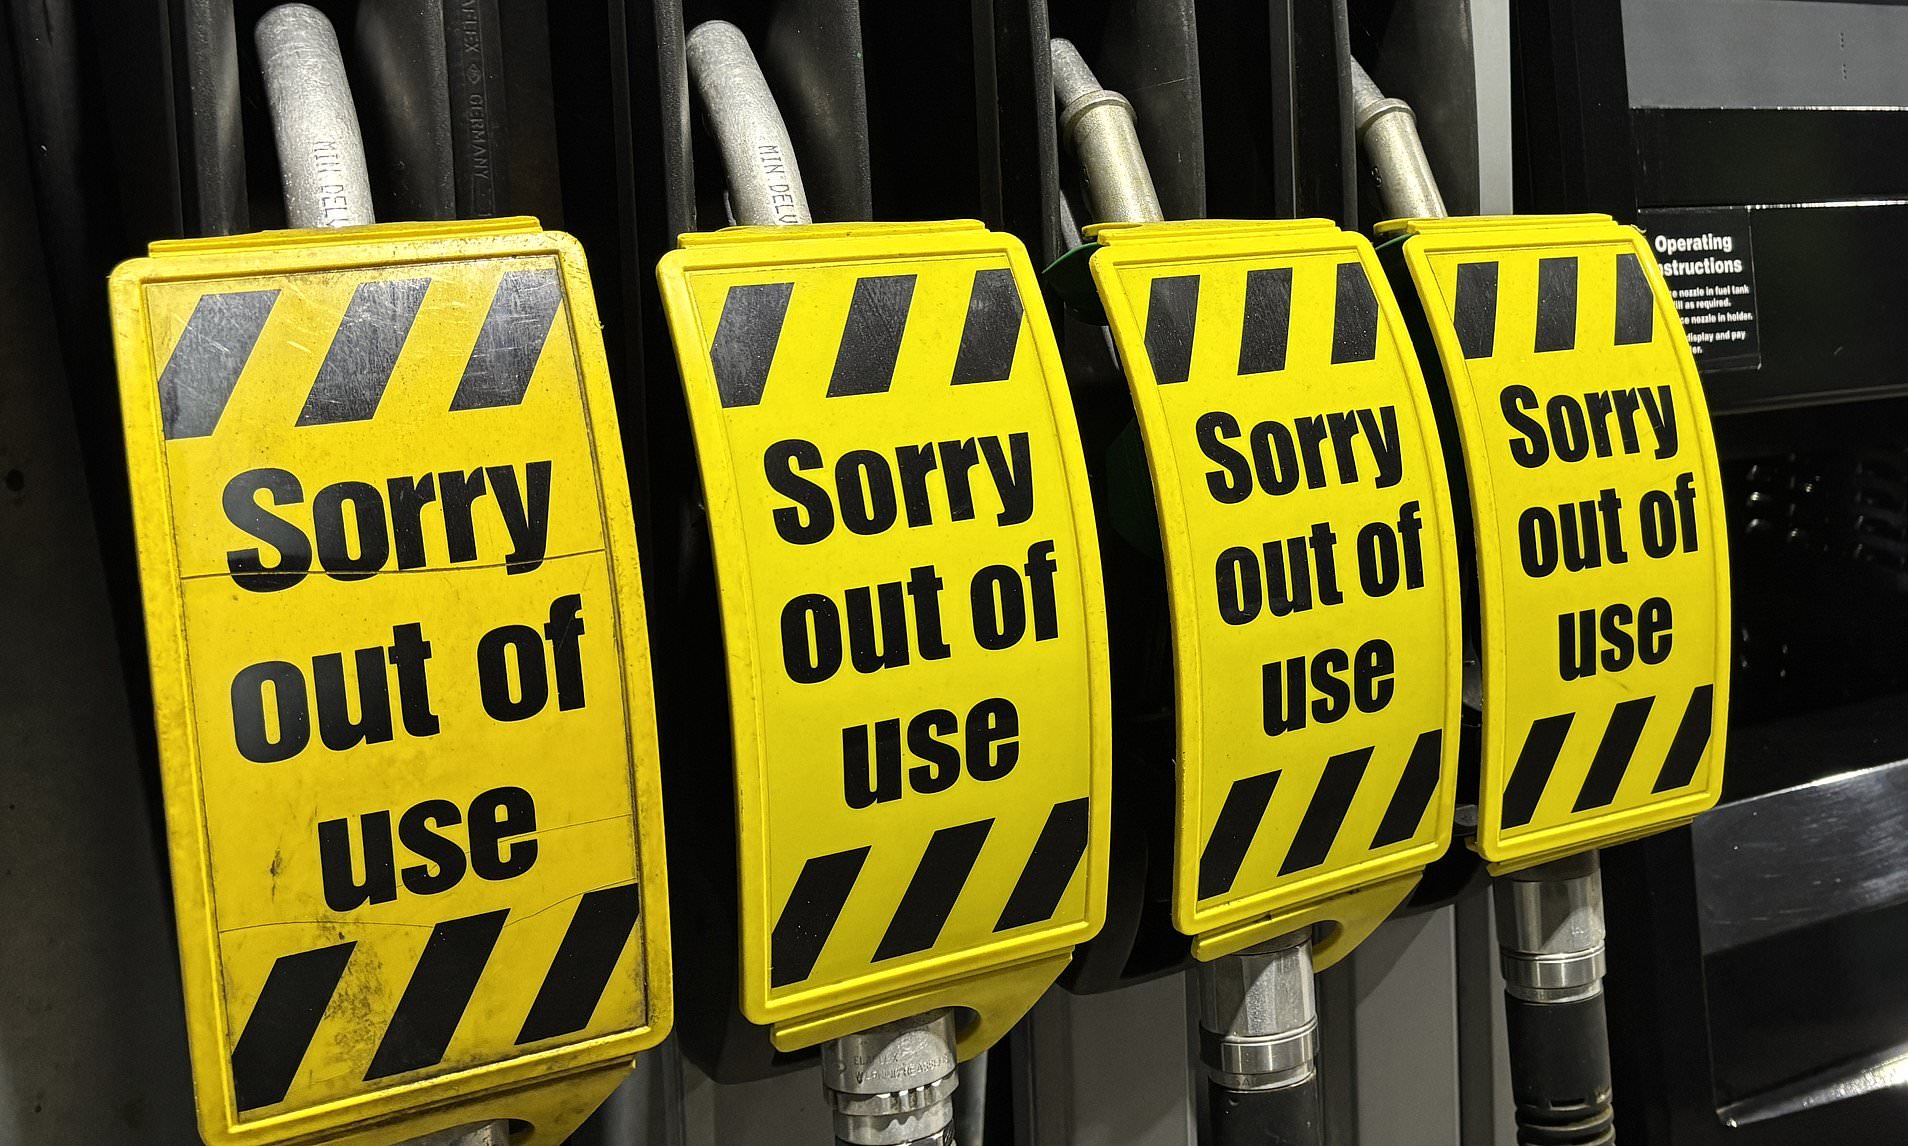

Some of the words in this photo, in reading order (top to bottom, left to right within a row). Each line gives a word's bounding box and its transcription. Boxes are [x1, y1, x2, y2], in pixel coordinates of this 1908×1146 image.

[468, 93, 490, 180] GERMANY
[758, 145, 785, 174] MIN
[1654, 233, 1733, 255] Operating
[1679, 286, 1705, 298] nozzle
[1706, 286, 1714, 296] in
[1715, 285, 1730, 296] fuel
[1732, 284, 1749, 295] tank
[1685, 301, 1695, 310] as
[1696, 297, 1731, 310] required.
[1691, 313, 1716, 325] nozzle
[1717, 312, 1726, 322] in
[1727, 311, 1753, 322] holder.
[1715, 330, 1731, 341] and
[1731, 330, 1746, 342] pay
[1196, 406, 1402, 504] Sorry
[1500, 385, 1678, 468] Sorry
[222, 460, 552, 592] Sorry
[764, 432, 1033, 545] Sorry
[1519, 488, 1628, 577] out
[1640, 472, 1698, 558] of
[1216, 522, 1343, 625] out
[1357, 501, 1424, 597] of
[781, 565, 951, 684] out
[971, 540, 1058, 650] of
[1559, 597, 1672, 681] use
[231, 623, 440, 763] out
[477, 594, 585, 721] of
[1262, 639, 1394, 736] use
[842, 698, 1019, 809] use
[318, 786, 538, 912] use
